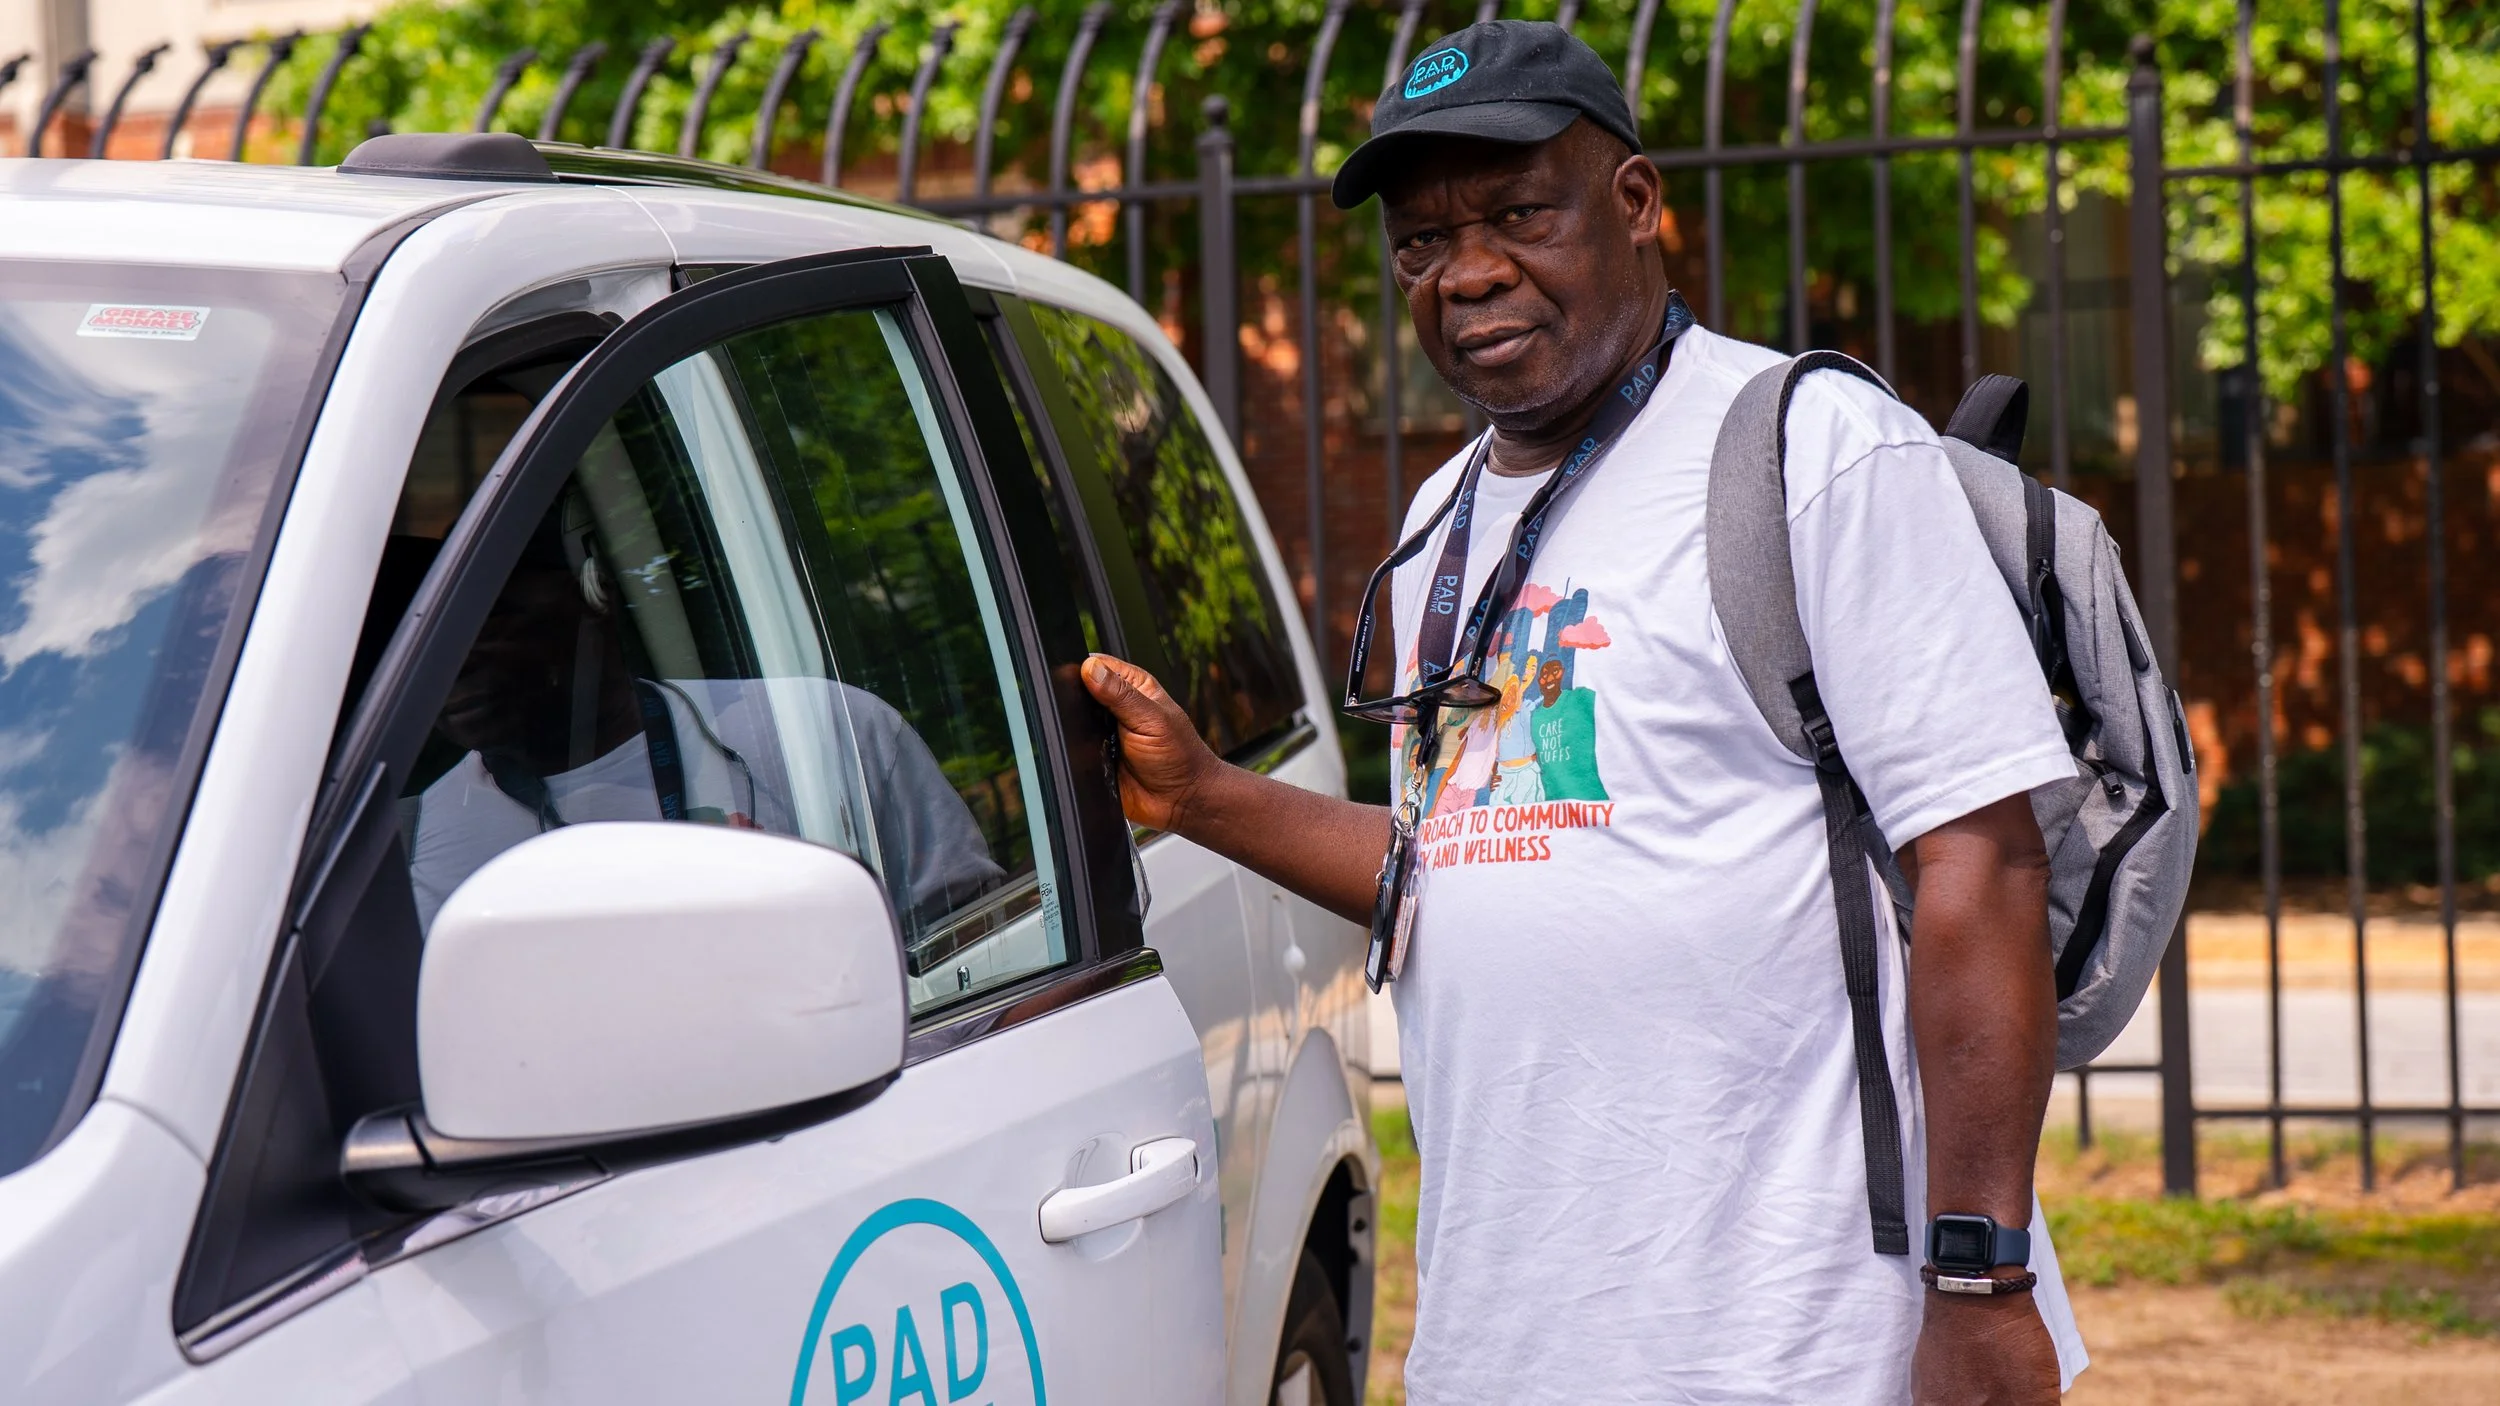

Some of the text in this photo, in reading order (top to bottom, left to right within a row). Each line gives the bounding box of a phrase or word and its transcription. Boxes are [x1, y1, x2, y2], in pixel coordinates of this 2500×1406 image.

[1413, 64, 1455, 86] INITIATIVE
[1415, 56, 1456, 81] PAD
[91, 316, 197, 330] MONKEY
[104, 308, 196, 321] GREASE
[1620, 363, 1657, 402] PAD
[1566, 437, 1597, 476] PAD
[1456, 489, 1472, 529] PAD
[1429, 575, 1445, 613] INITIATIVE
[1437, 575, 1459, 615] PAD
[1539, 718, 1563, 738] CARE
[1542, 734, 1562, 751] NOT
[1540, 745, 1570, 765] CUFFS
[1419, 802, 1616, 846] PROACH TO COMMUNITY
[1432, 843, 1459, 871] AND
[1464, 835, 1551, 865] WELLNESS
[830, 1281, 989, 1406] PAD
